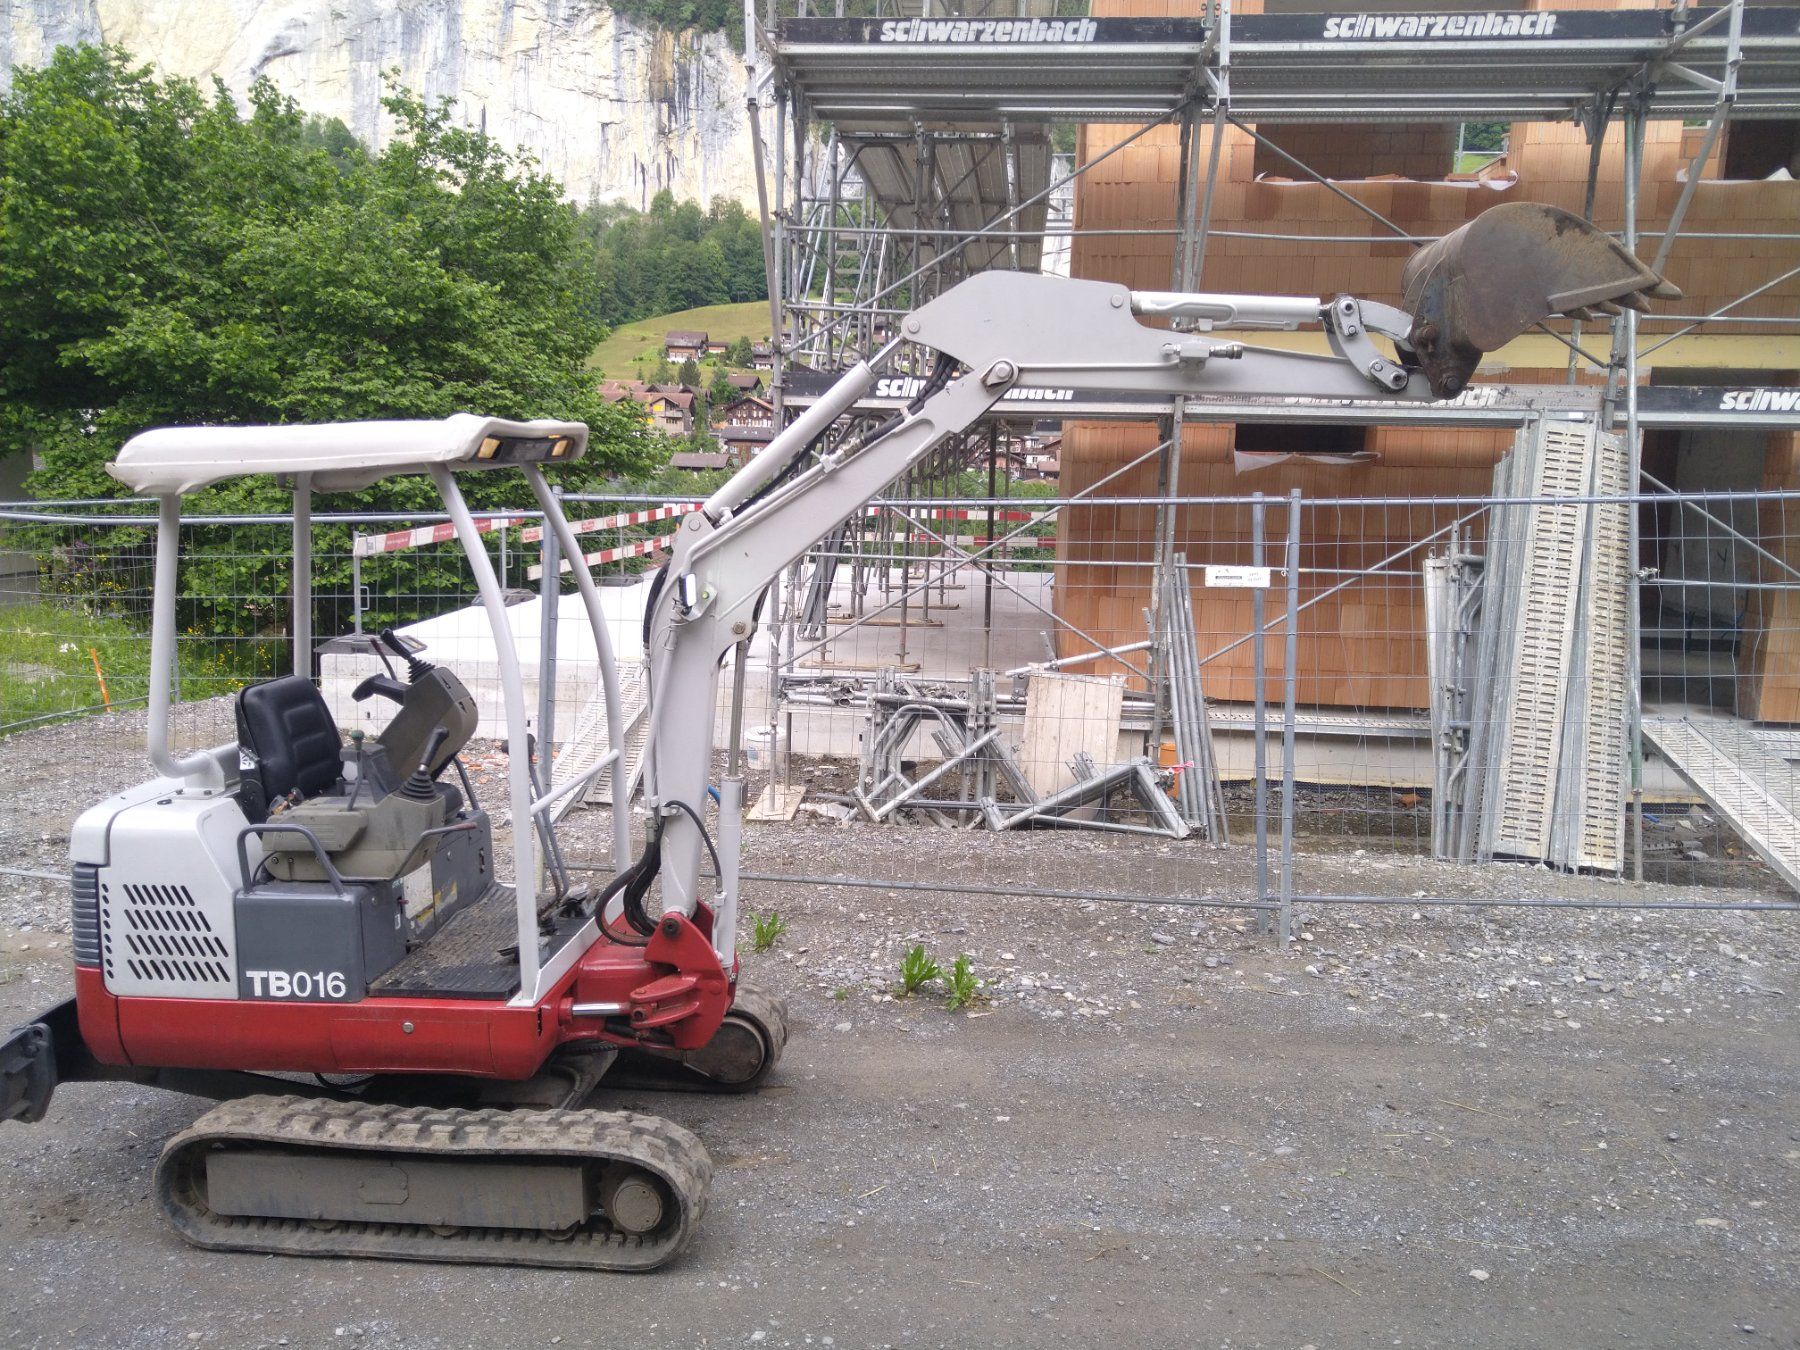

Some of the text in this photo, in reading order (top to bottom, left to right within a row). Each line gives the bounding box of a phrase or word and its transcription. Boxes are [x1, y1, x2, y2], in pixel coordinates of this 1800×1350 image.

[880, 18, 1098, 42] schwarzenbach
[1323, 12, 1557, 39] schwarzenbach
[246, 970, 347, 998] TB016
